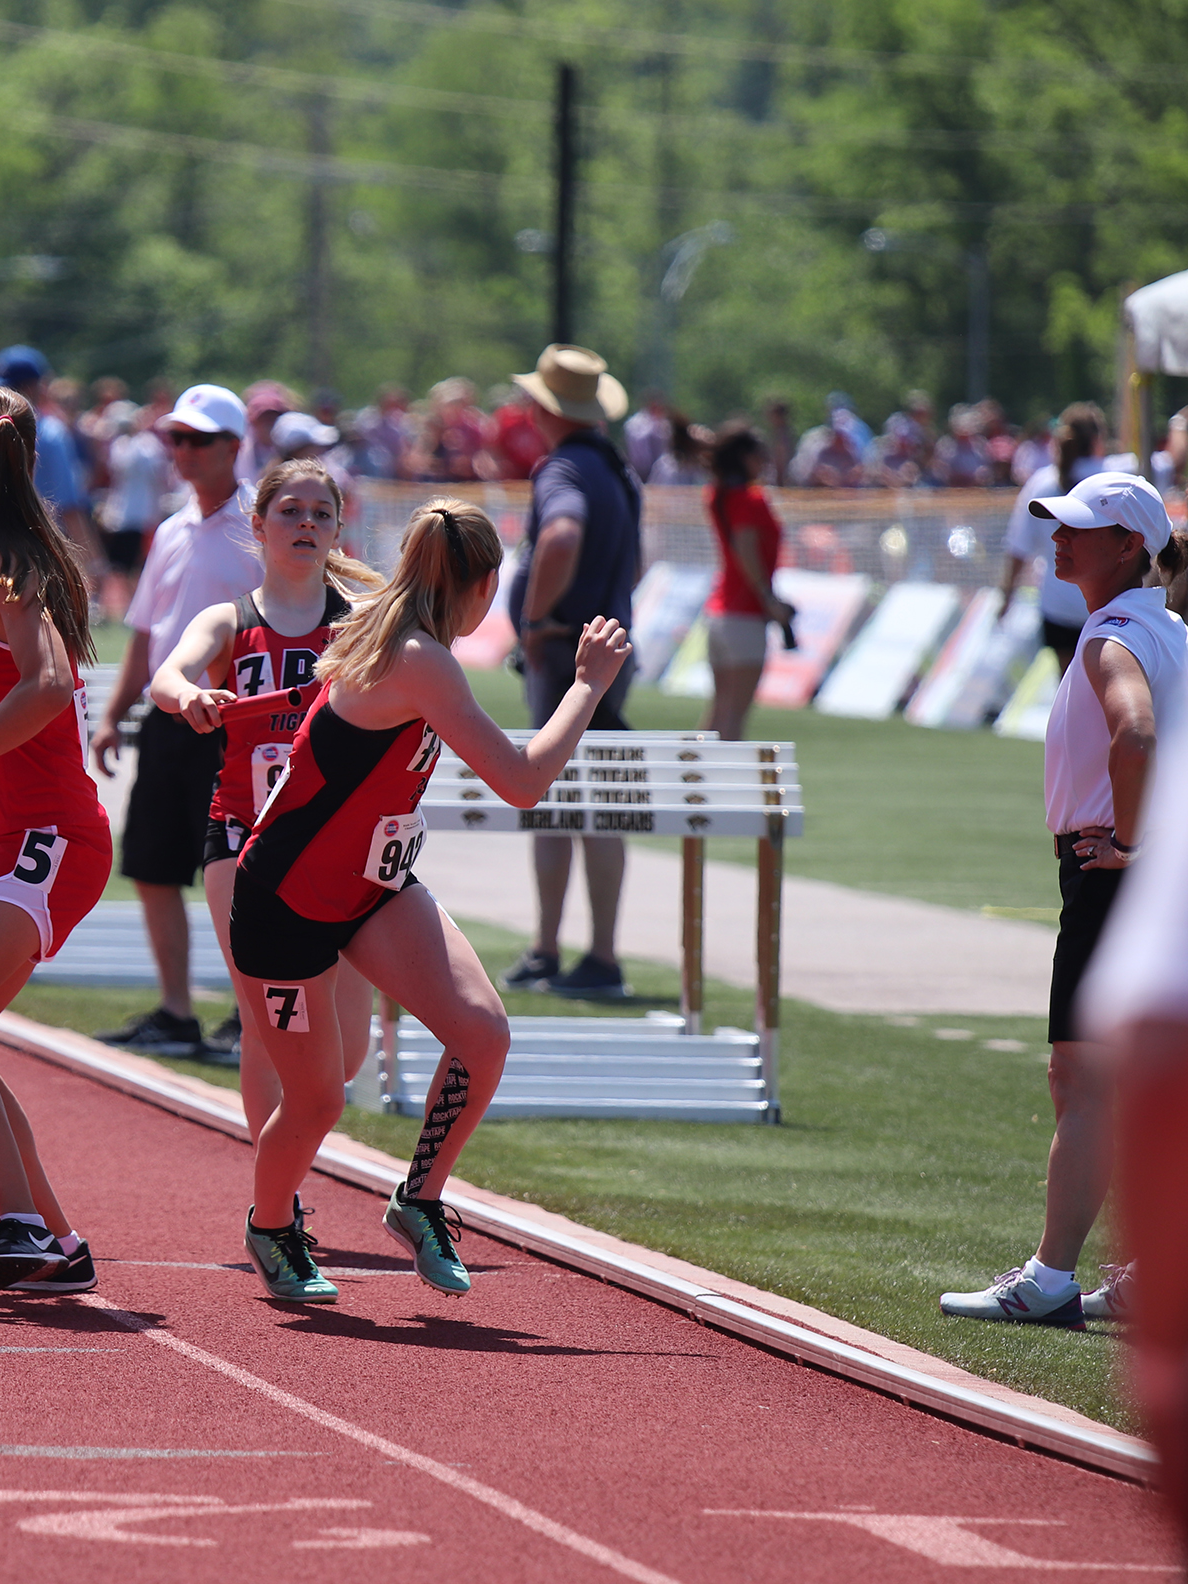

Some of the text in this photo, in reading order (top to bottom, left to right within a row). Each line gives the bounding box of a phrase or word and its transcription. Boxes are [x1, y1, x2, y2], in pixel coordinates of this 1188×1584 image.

[238, 656, 265, 697] 7
[280, 648, 319, 690] P
[520, 809, 654, 831] HIGHLAND COUGARS
[14, 831, 56, 885] 5
[266, 987, 300, 1030] 7
